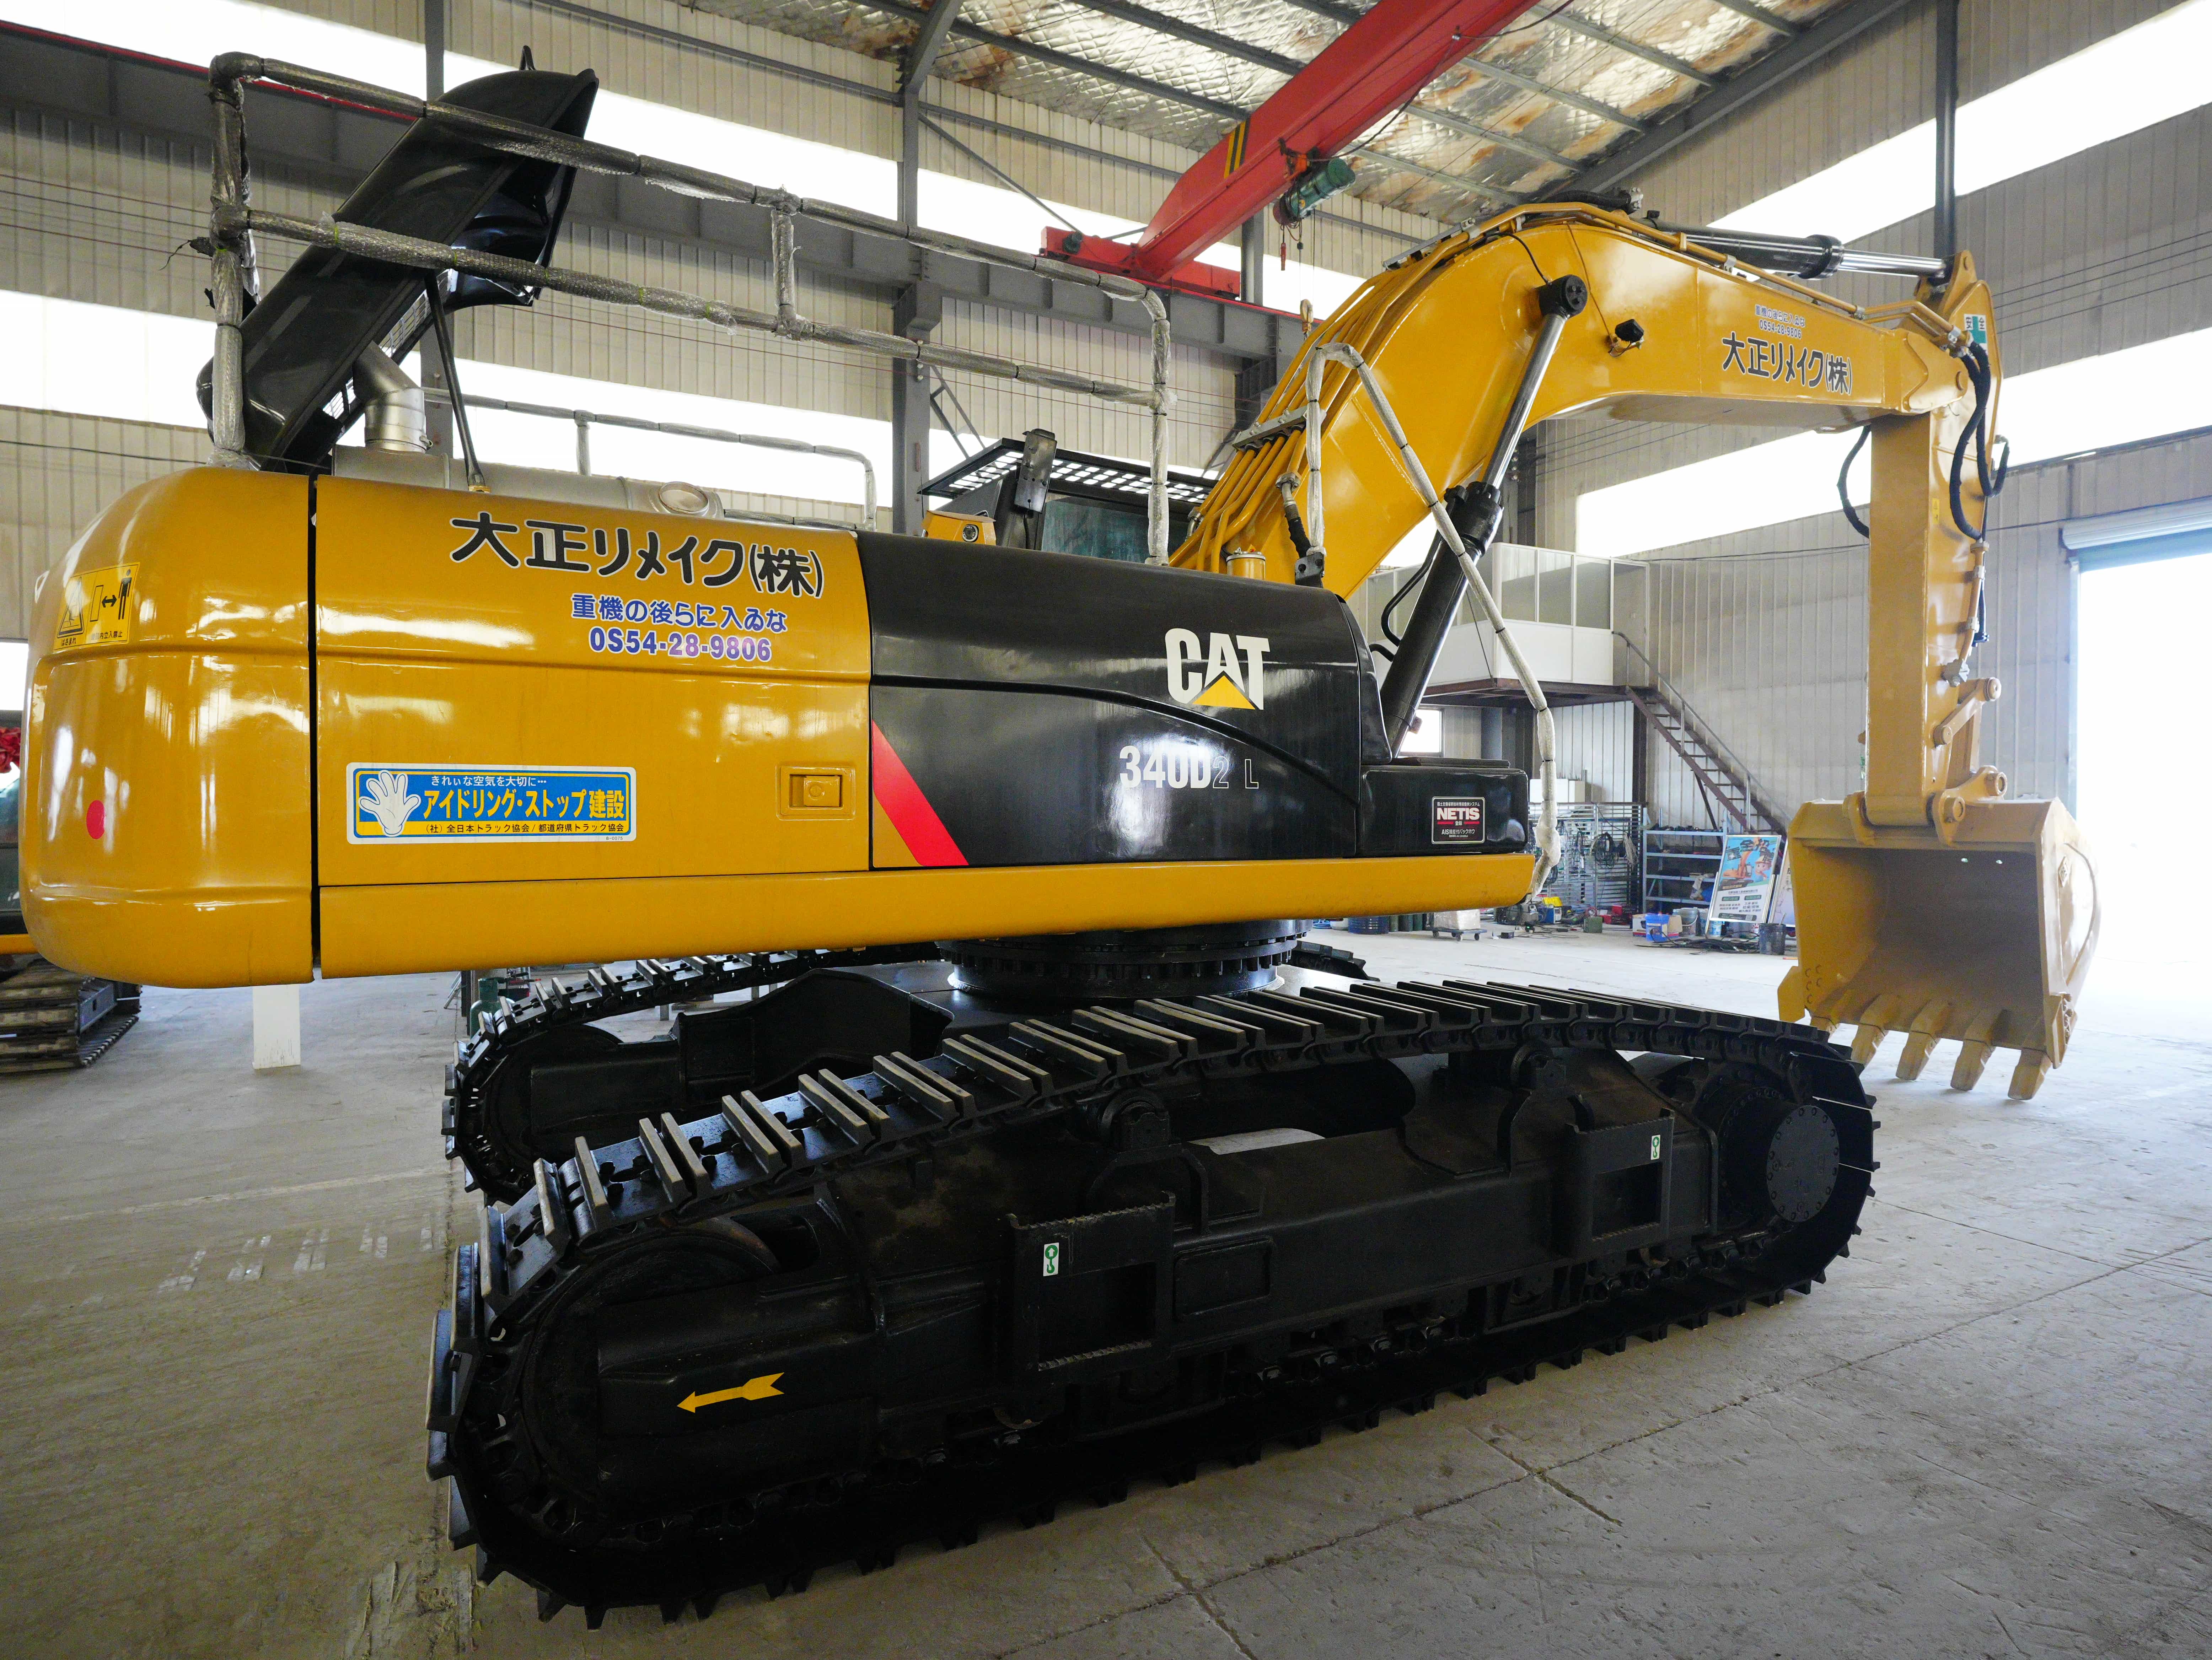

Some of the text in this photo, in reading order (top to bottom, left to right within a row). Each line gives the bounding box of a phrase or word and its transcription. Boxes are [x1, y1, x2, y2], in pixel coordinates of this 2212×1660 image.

[1165, 628, 1271, 710] CAT
[1245, 759, 1259, 789] L
[1437, 807, 1480, 820] NETIS
